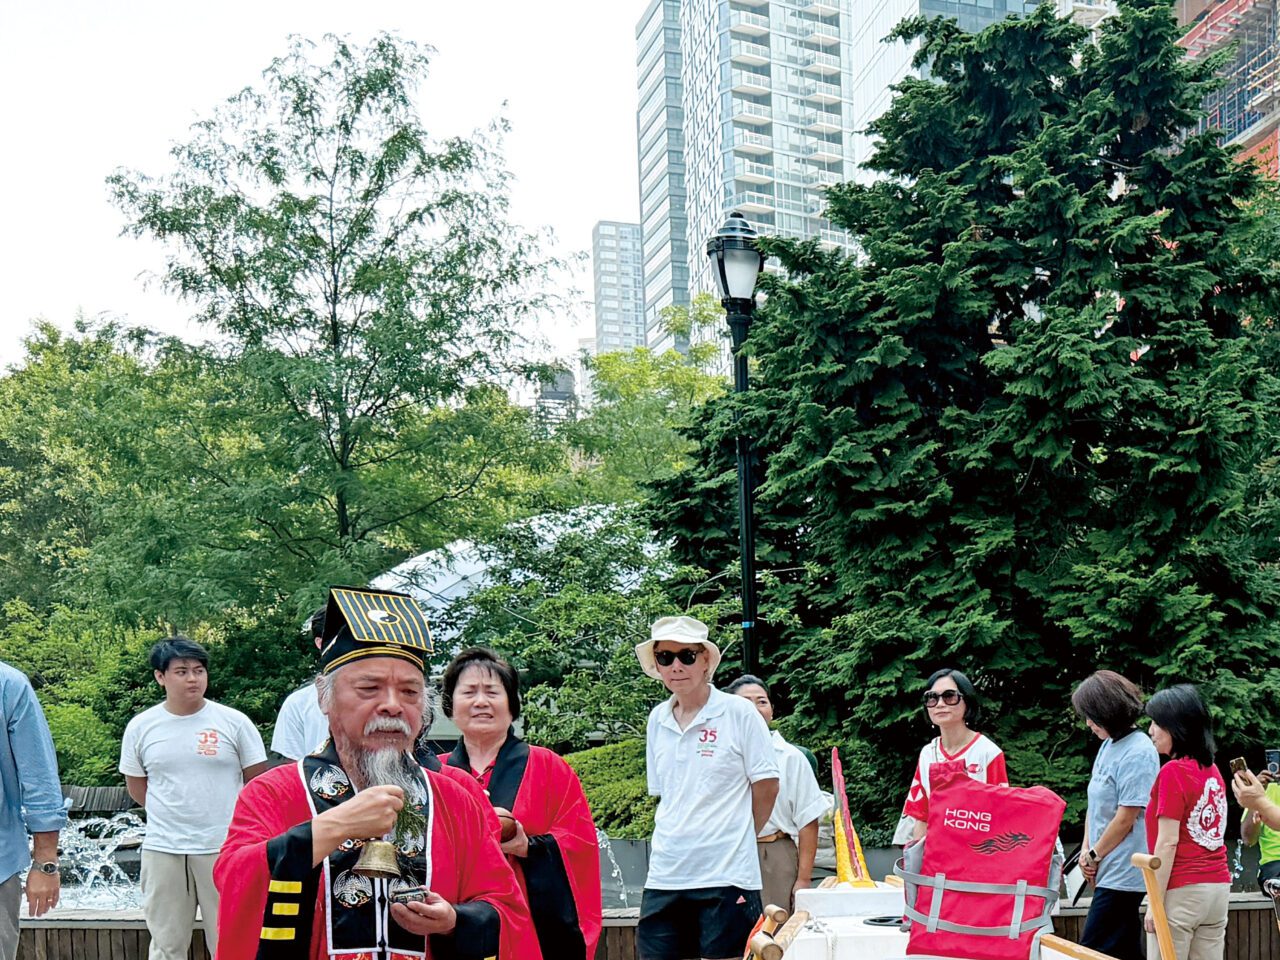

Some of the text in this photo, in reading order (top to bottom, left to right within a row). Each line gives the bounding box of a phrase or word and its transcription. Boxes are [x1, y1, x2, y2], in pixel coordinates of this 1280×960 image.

[696, 729, 717, 743] 35
[945, 808, 992, 822] HONG
[943, 818, 991, 832] KONG
